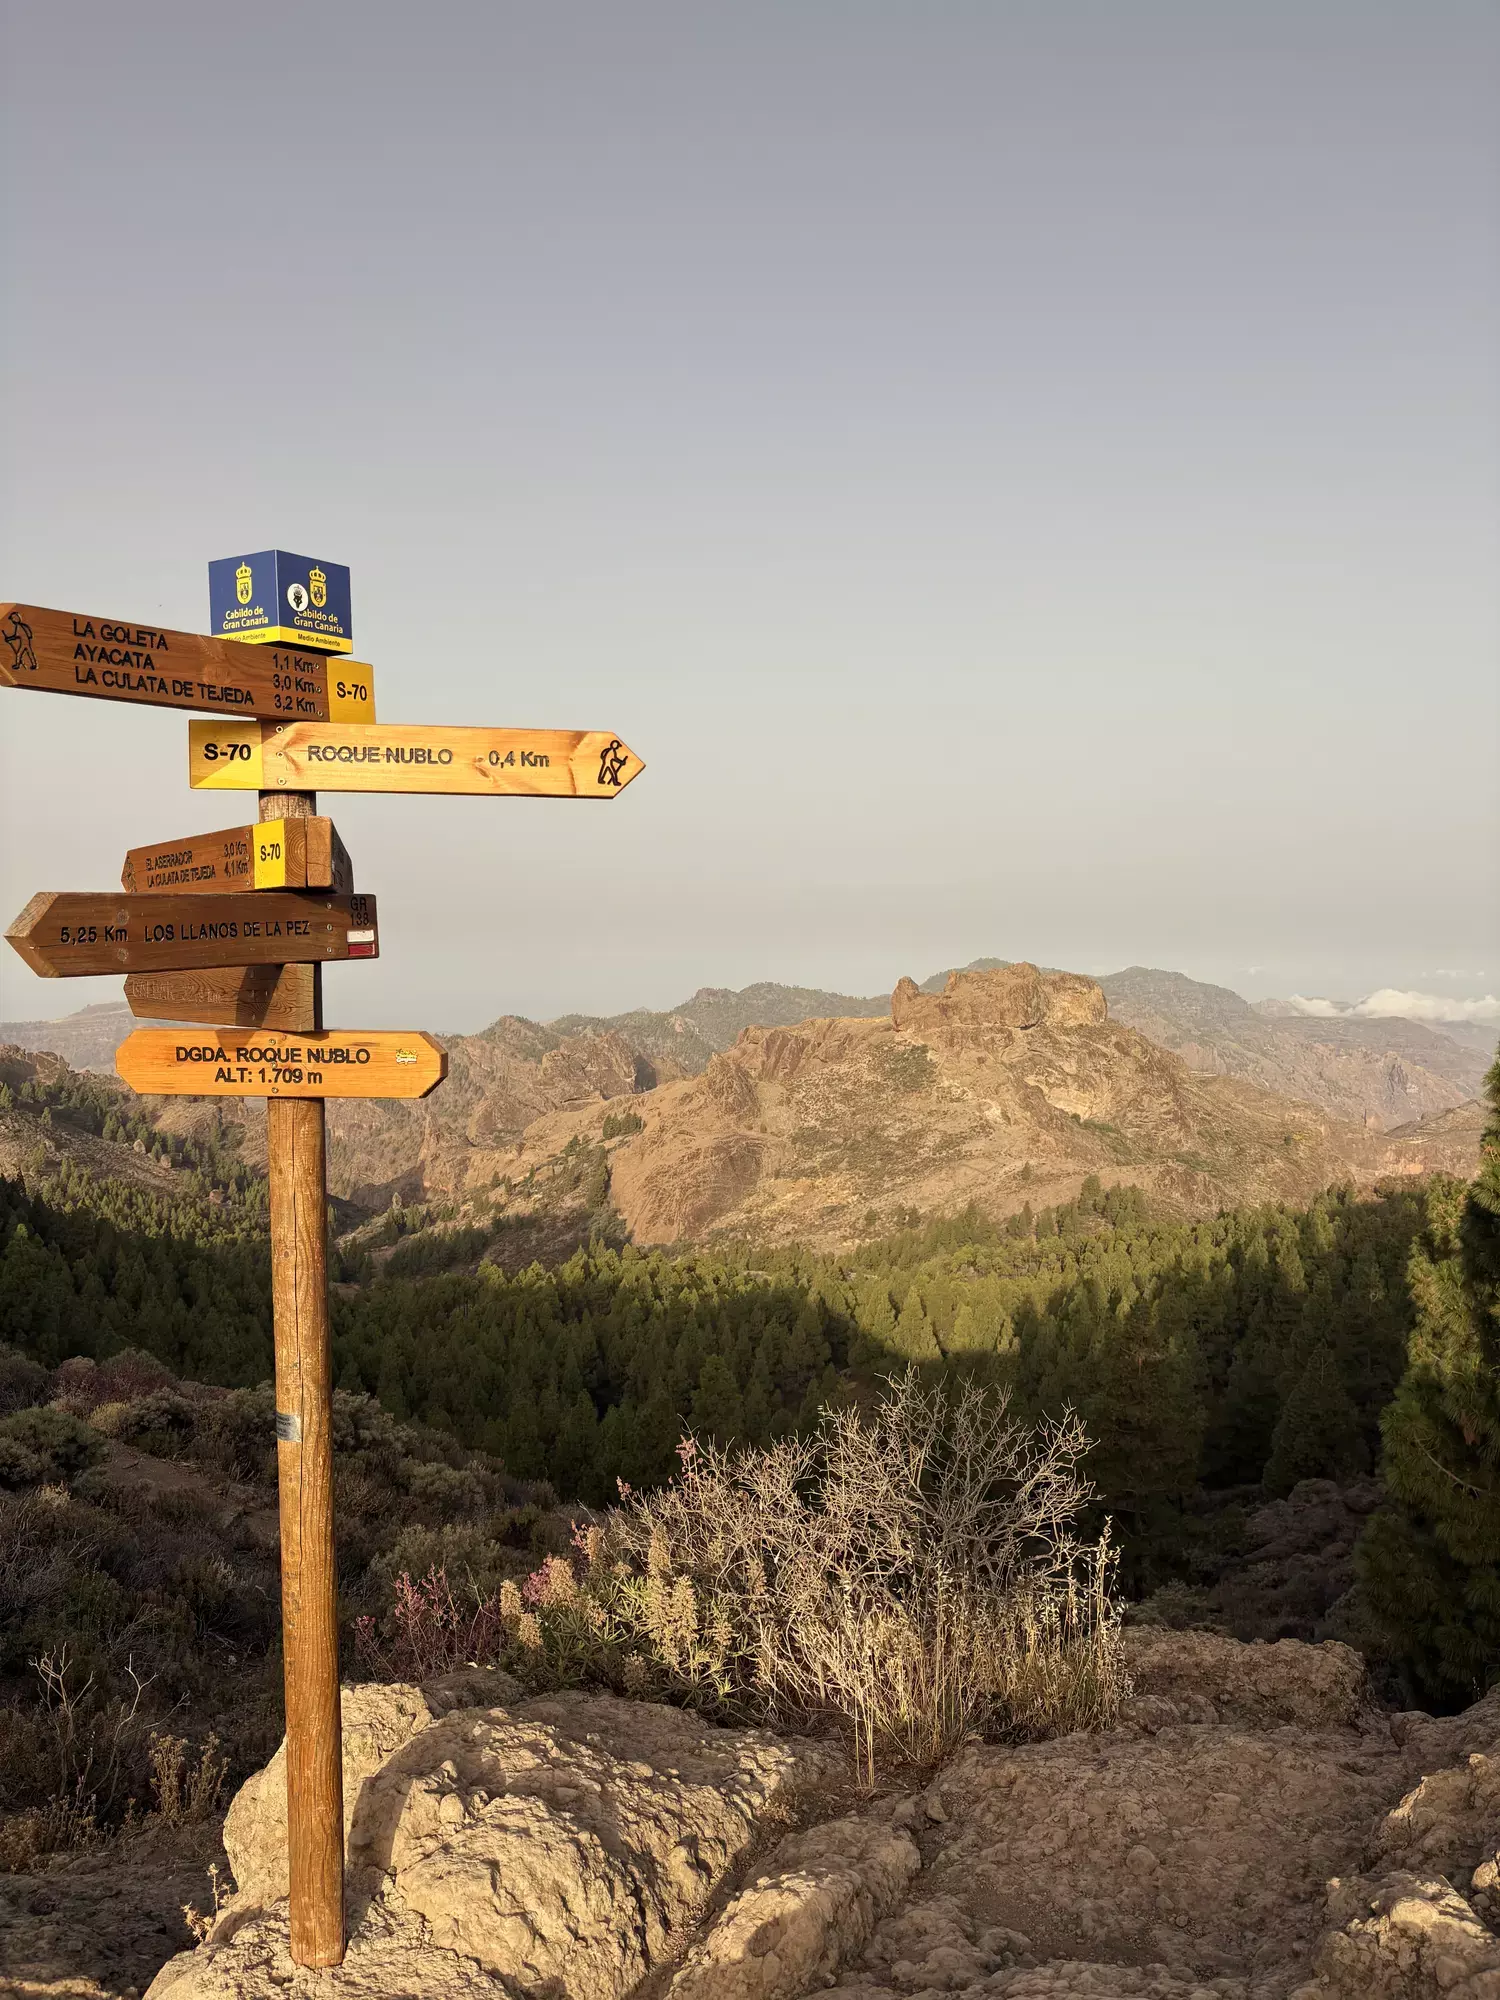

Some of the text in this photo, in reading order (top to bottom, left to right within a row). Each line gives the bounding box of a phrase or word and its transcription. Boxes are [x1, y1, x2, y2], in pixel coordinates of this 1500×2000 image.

[225, 606, 264, 620] Cabildo de
[328, 612, 339, 624] de
[223, 615, 269, 630] Gran Canaria
[293, 616, 344, 634] Gran Canaria
[242, 633, 266, 641] Ambiente
[297, 633, 341, 647] Medio Ambiente
[73, 619, 314, 674] LA GOLETA 1,1 Km
[74, 643, 316, 694] AYACATA 3,0 Km
[75, 666, 316, 713] LA CULATA DE TEJEDA 3,2 Km
[336, 682, 367, 701] S-70
[204, 743, 252, 761] S-70
[307, 745, 550, 768] ROQUE NUBLO 0,4 Km
[145, 841, 248, 871] EL ASERRADOR 3,0 Km
[260, 843, 281, 862] S-70
[147, 860, 248, 888] LA CULATA DE TEJEDA 4,1 Km
[350, 896, 367, 912] GR
[350, 911, 370, 927] 138
[60, 920, 310, 945] 5,25 Km LOS LLANOS DE LA PEZ
[175, 1046, 370, 1065] DGDA. ROQUE NUBLO
[214, 1067, 323, 1084] ALT: 1.709 m
